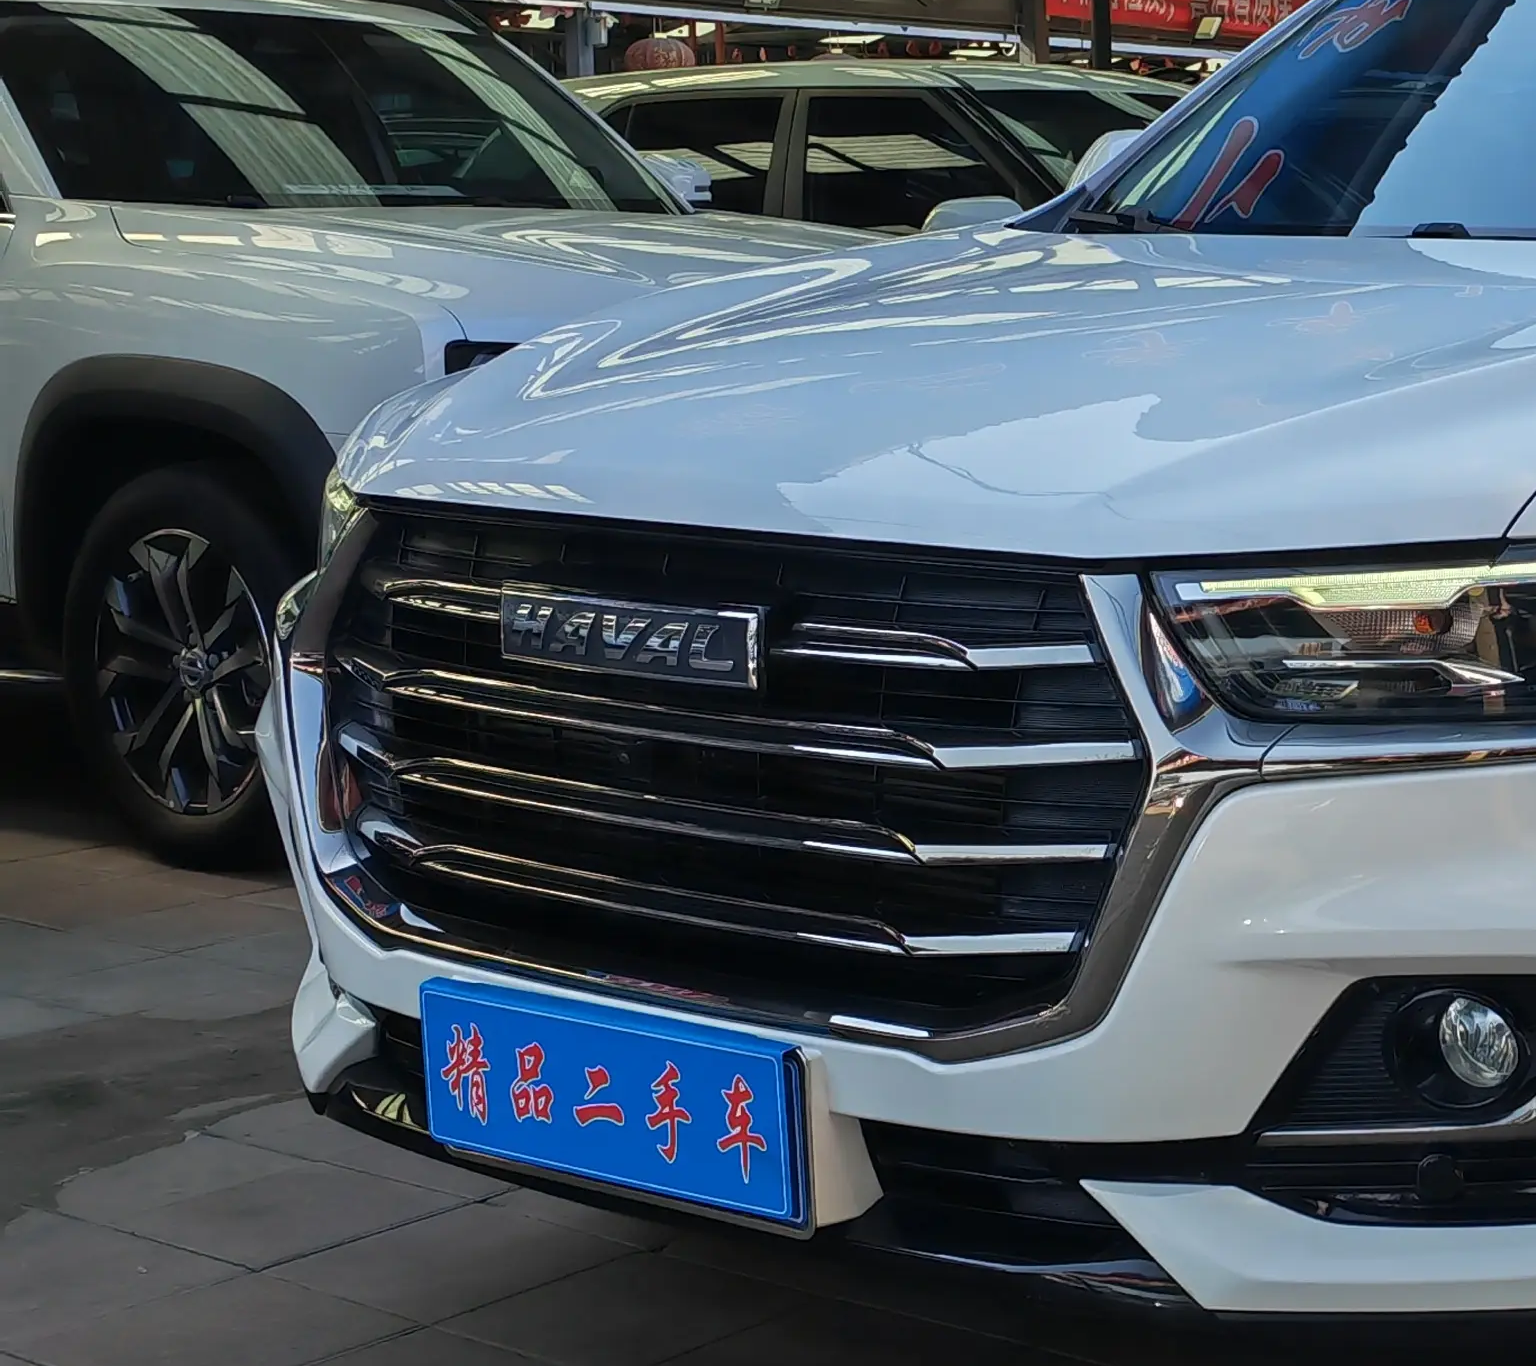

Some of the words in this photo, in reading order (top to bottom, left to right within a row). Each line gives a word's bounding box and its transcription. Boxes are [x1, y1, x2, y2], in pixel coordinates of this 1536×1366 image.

[510, 602, 735, 673] HAVAL
[440, 1021, 768, 1184] 精品二手车
